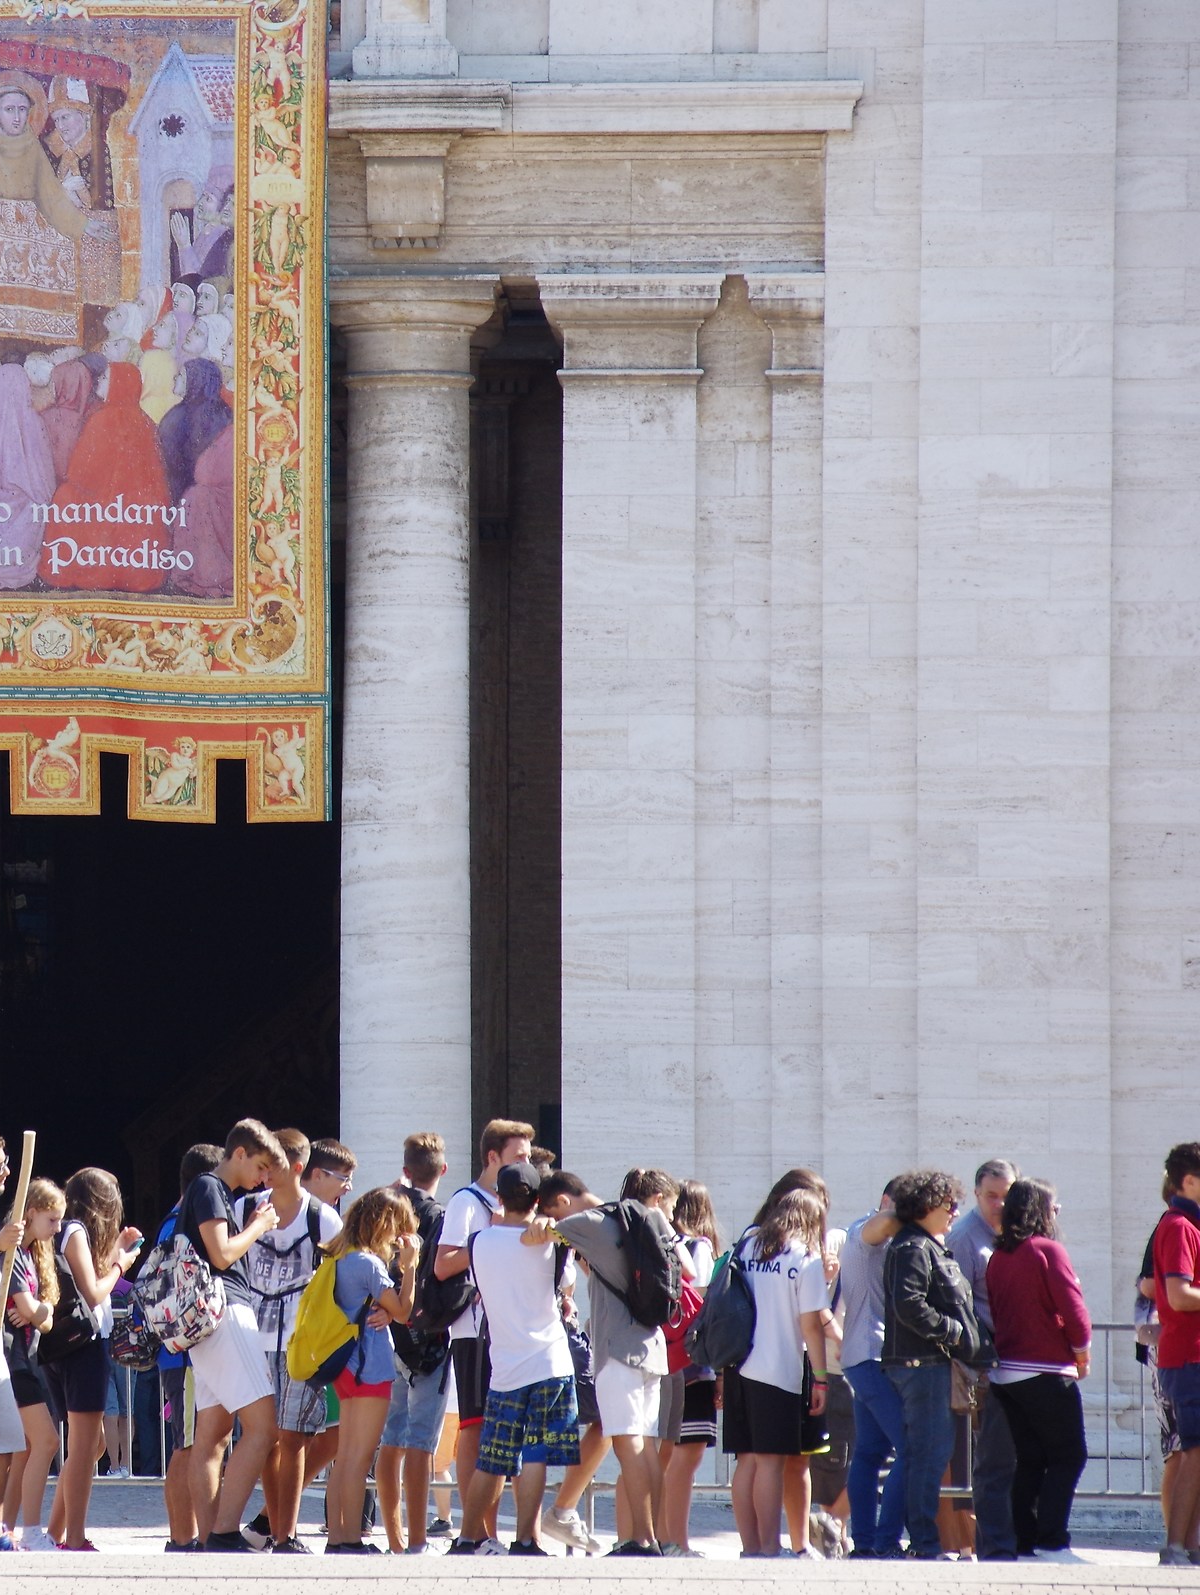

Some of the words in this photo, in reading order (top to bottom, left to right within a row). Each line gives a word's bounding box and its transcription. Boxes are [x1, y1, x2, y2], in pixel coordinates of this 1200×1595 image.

[31, 493, 187, 528] mandarvi
[42, 536, 194, 575] Paradiso
[740, 1259, 782, 1275] ARTINA
[787, 1267, 799, 1280] C
